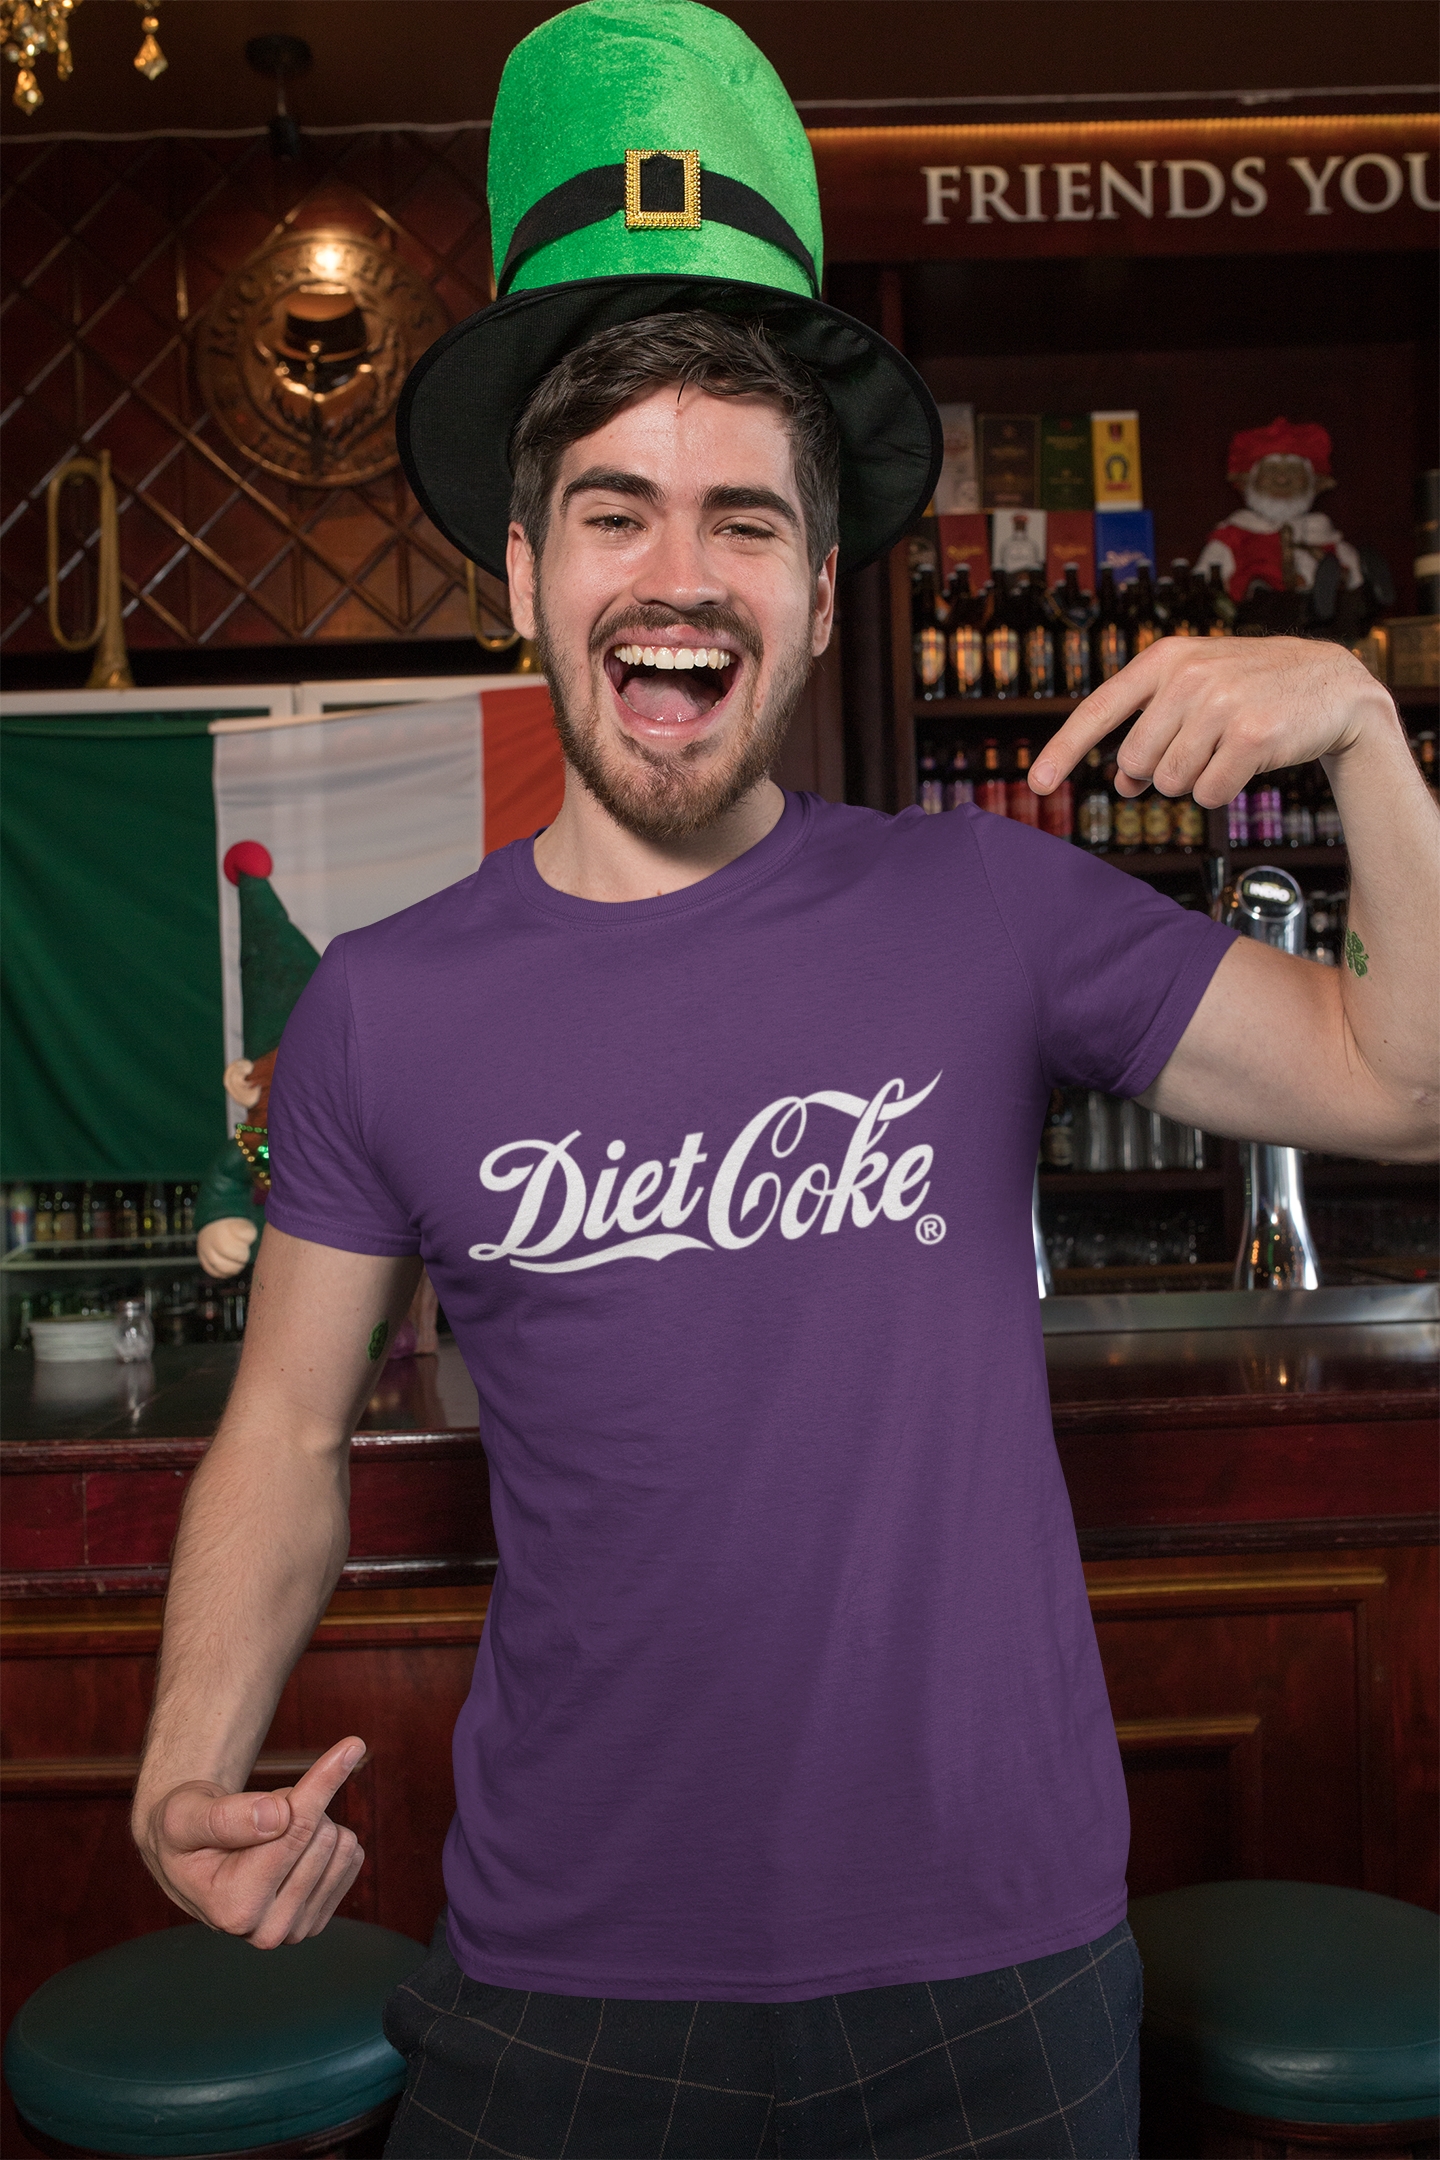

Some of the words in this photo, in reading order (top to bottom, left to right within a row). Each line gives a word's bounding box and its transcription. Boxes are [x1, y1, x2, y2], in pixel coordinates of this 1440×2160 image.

[922, 157, 1268, 224] FRIENDS
[1288, 153, 1440, 215] YOU
[468, 1130, 708, 1264] Diet
[707, 1069, 943, 1250] Coke
